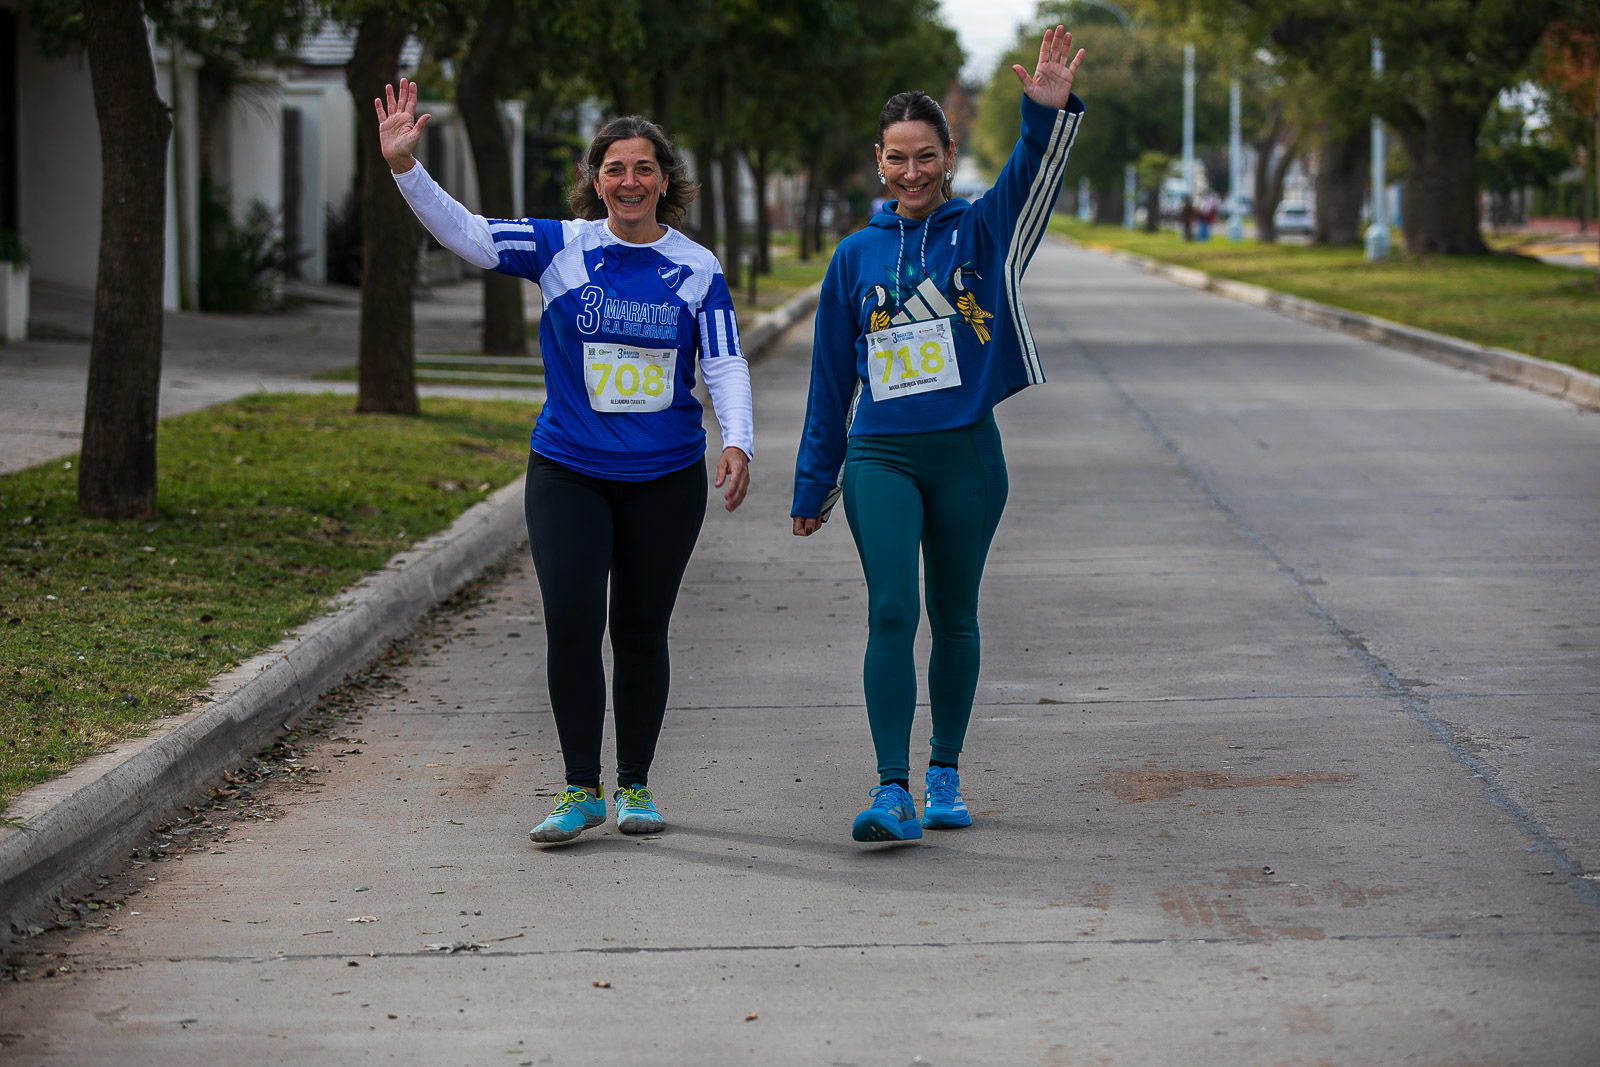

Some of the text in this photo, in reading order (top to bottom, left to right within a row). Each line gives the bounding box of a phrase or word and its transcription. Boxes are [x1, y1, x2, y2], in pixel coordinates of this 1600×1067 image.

[577, 286, 680, 334] 3 MARATÓN
[617, 347, 623, 359] 3
[892, 332, 898, 344] 3
[875, 342, 944, 384] 718
[592, 364, 664, 396] 708
